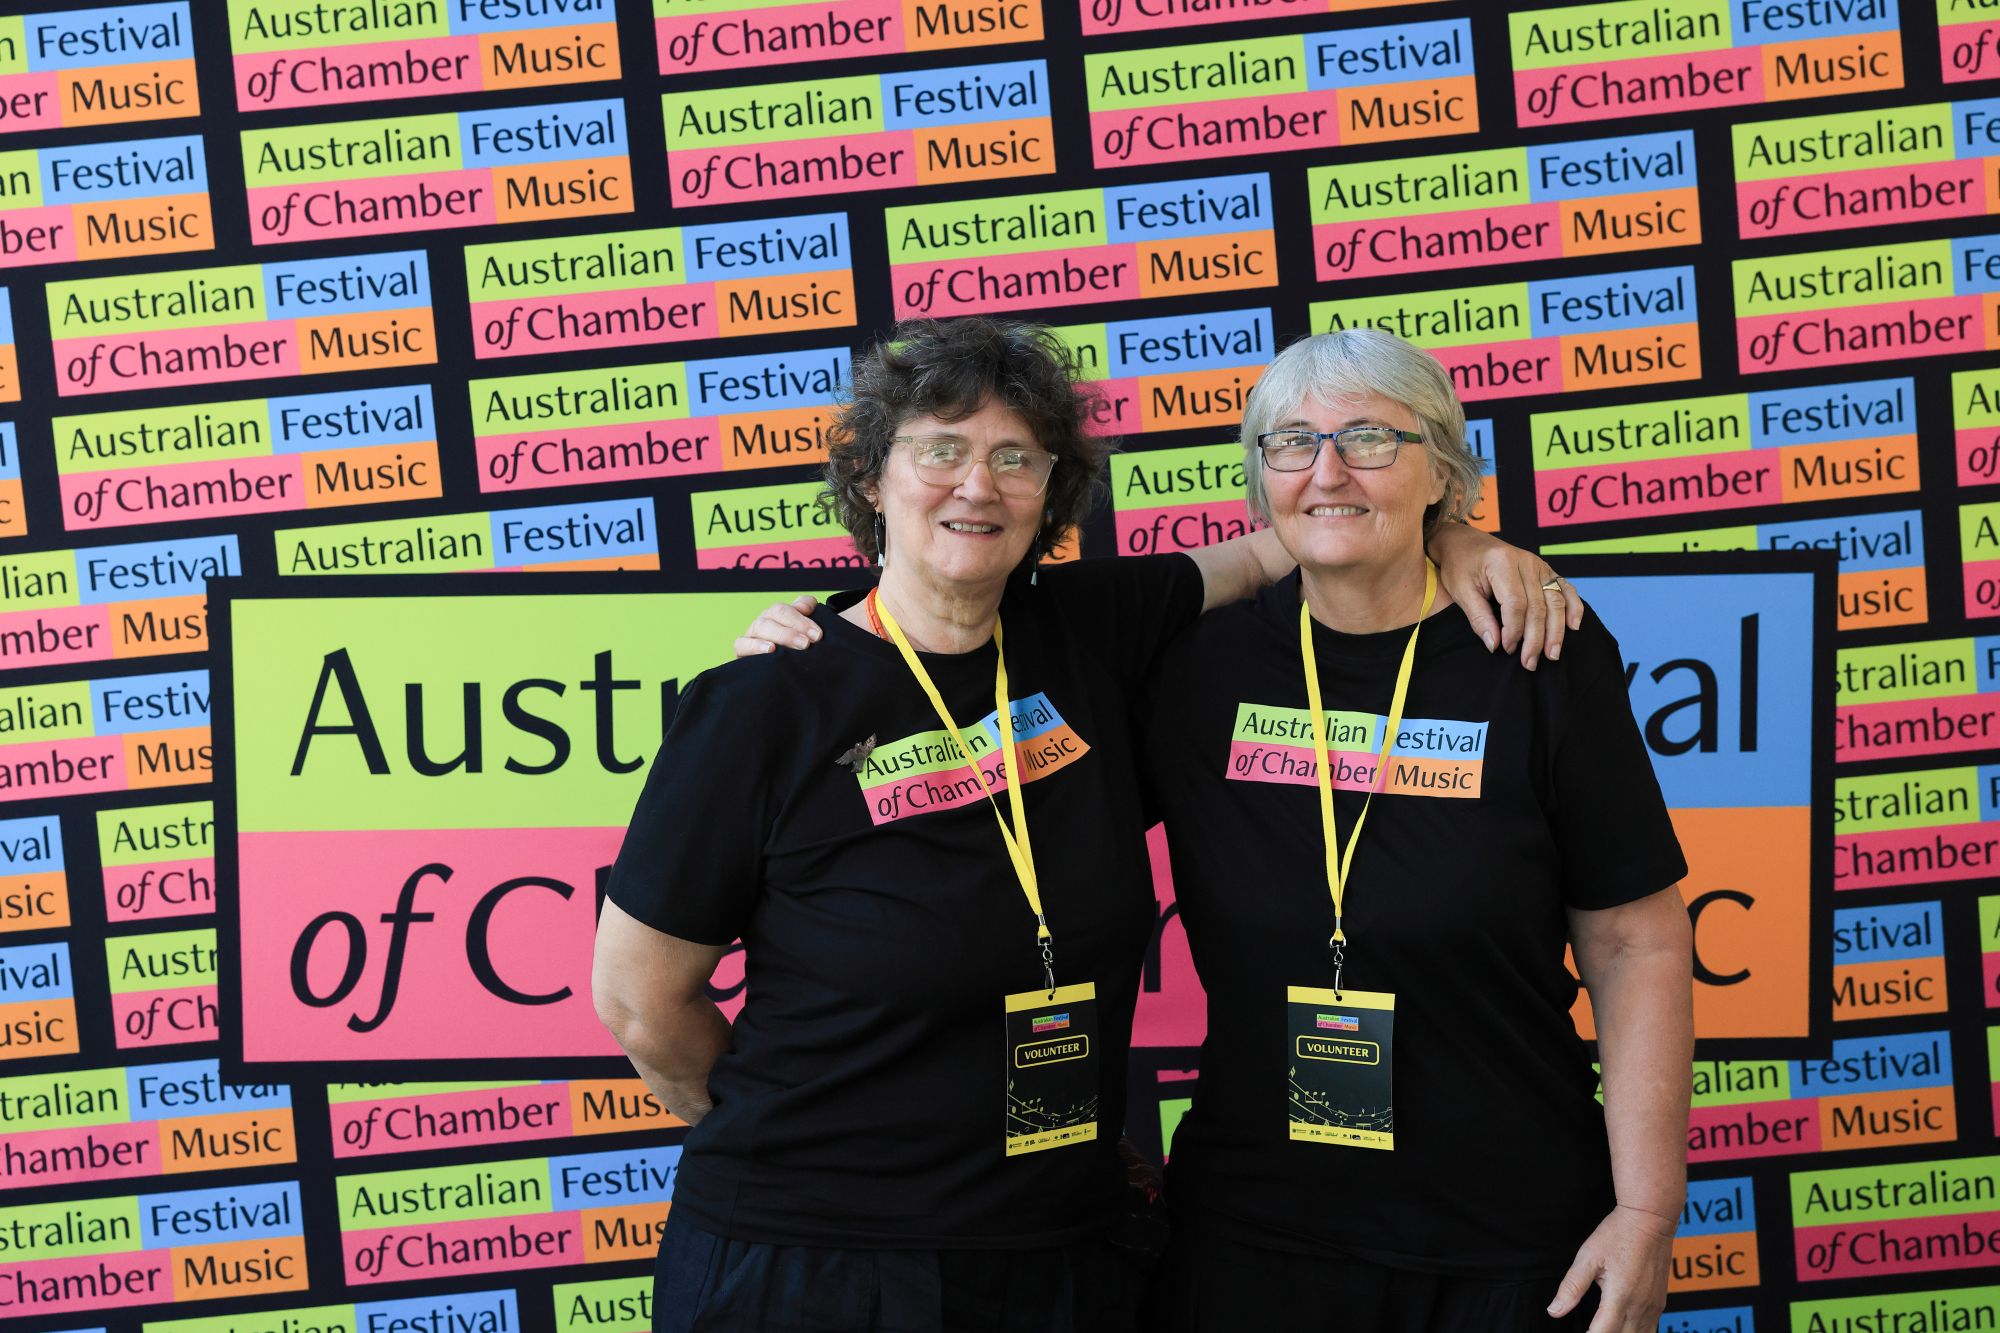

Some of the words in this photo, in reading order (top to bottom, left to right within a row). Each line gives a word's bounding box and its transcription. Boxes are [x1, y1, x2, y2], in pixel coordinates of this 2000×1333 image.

[37, 11, 182, 58] Festival
[669, 21, 709, 66] of
[712, 11, 892, 56] Chamber
[916, 0, 1028, 38] Music
[1525, 8, 1720, 56] Australian
[1953, 29, 1993, 74] of
[247, 59, 286, 103] of
[290, 49, 469, 93] Chamber
[493, 35, 606, 76] Music
[1101, 50, 1295, 98] Australian
[1317, 28, 1461, 77] Festival
[1527, 74, 1567, 119] of
[1570, 62, 1752, 109] Chamber
[1775, 44, 1888, 87] Music
[72, 72, 184, 113] Music
[679, 90, 872, 137] Australian
[894, 69, 1037, 117] Festival
[258, 128, 451, 174] Australian
[472, 108, 615, 155] Festival
[1103, 115, 1143, 161] of
[1146, 105, 1327, 151] Chamber
[1351, 89, 1463, 131] Music
[1748, 119, 1943, 167] Australian
[52, 145, 194, 192] Festival
[681, 155, 721, 199] of
[724, 144, 904, 190] Chamber
[927, 129, 1041, 171] Music
[1324, 163, 1518, 211] Australian
[1540, 140, 1684, 189] Festival
[87, 206, 197, 246] Music
[261, 192, 300, 237] of
[304, 182, 483, 227] Chamber
[506, 168, 619, 209] Music
[901, 204, 1095, 251] Australian
[1117, 183, 1260, 231] Festival
[1749, 185, 1789, 230] of
[1792, 174, 1974, 220] Chamber
[481, 242, 674, 289] Australian
[695, 222, 838, 270] Festival
[1326, 228, 1366, 273] of
[1369, 217, 1550, 263] Chamber
[1573, 201, 1685, 243] Music
[63, 280, 255, 325] Australian
[276, 260, 418, 307] Festival
[904, 268, 944, 313] of
[947, 257, 1127, 303] Chamber
[1150, 242, 1263, 284] Music
[1541, 276, 1684, 324] Festival
[1748, 255, 1942, 303] Australian
[484, 306, 524, 351] of
[527, 296, 706, 341] Chamber
[729, 282, 842, 323] Music
[1119, 318, 1262, 365] Festival
[1749, 320, 1789, 365] of
[1792, 309, 1973, 355] Chamber
[67, 343, 106, 388] of
[109, 334, 287, 378] Chamber
[310, 319, 422, 360] Music
[1449, 352, 1551, 389] mber
[1574, 336, 1686, 377] Music
[486, 377, 678, 423] Australian
[698, 357, 840, 404] Festival
[70, 414, 260, 460] Australian
[281, 394, 423, 441] Festival
[1546, 409, 1739, 457] Australian
[1761, 387, 1903, 436] Festival
[489, 440, 528, 484] of
[531, 430, 710, 475] Chamber
[733, 416, 824, 457] Musi
[1968, 435, 2000, 478] of
[73, 478, 112, 522] of
[115, 468, 293, 512] Chamber
[315, 454, 427, 494] Music
[1126, 459, 1248, 497] Austra
[1547, 474, 1588, 519] of
[1590, 463, 1770, 509] Chamber
[1793, 447, 1905, 489] Music
[292, 527, 482, 573] Australian
[503, 507, 645, 554] Festival
[708, 498, 837, 536] Austra
[1128, 514, 1168, 553] of
[88, 545, 229, 592] Festival
[1839, 579, 1914, 618] usic
[0, 618, 100, 656] mber
[1836, 653, 1965, 694] tralian
[0, 696, 82, 733] alian
[103, 682, 209, 722] Festiv
[0, 750, 114, 789] amber
[137, 742, 213, 776] Mus
[1235, 747, 1264, 777] of
[1394, 764, 1474, 790] Music
[877, 785, 902, 819] of
[1835, 781, 1969, 823] stralian
[113, 816, 214, 853] Austr
[0, 884, 55, 920] sic
[117, 870, 155, 913] of
[290, 863, 454, 1032] of
[1834, 911, 1931, 953] stival
[0, 952, 60, 991] ival
[0, 1010, 64, 1048] usic
[125, 997, 164, 1041] of
[1024, 1042, 1080, 1060] VOLUNTEER
[1306, 1042, 1370, 1058] VOLUNTEER
[1692, 1060, 1779, 1096] alian
[1800, 1040, 1940, 1086] Festival
[0, 1082, 118, 1121] tralian
[343, 1107, 382, 1150] of
[385, 1096, 560, 1140] Chamber
[583, 1089, 669, 1123] Mus
[1688, 1111, 1809, 1151] amber
[1832, 1098, 1942, 1138] Music
[3, 1135, 150, 1176] hamber
[172, 1120, 281, 1160] Music
[352, 1173, 541, 1217] Australian
[561, 1158, 676, 1198] Festiv
[1683, 1186, 1744, 1225] ival
[1805, 1170, 1995, 1214] Australian
[0, 1211, 130, 1251] stralian
[151, 1191, 290, 1236] Festival
[184, 1248, 293, 1288] Music
[355, 1234, 394, 1278] of
[396, 1224, 572, 1268] Chamber
[594, 1217, 667, 1250] Mus
[1672, 1243, 1745, 1281] usic
[1807, 1231, 1846, 1274] of
[1848, 1222, 2000, 1265] Chambe
